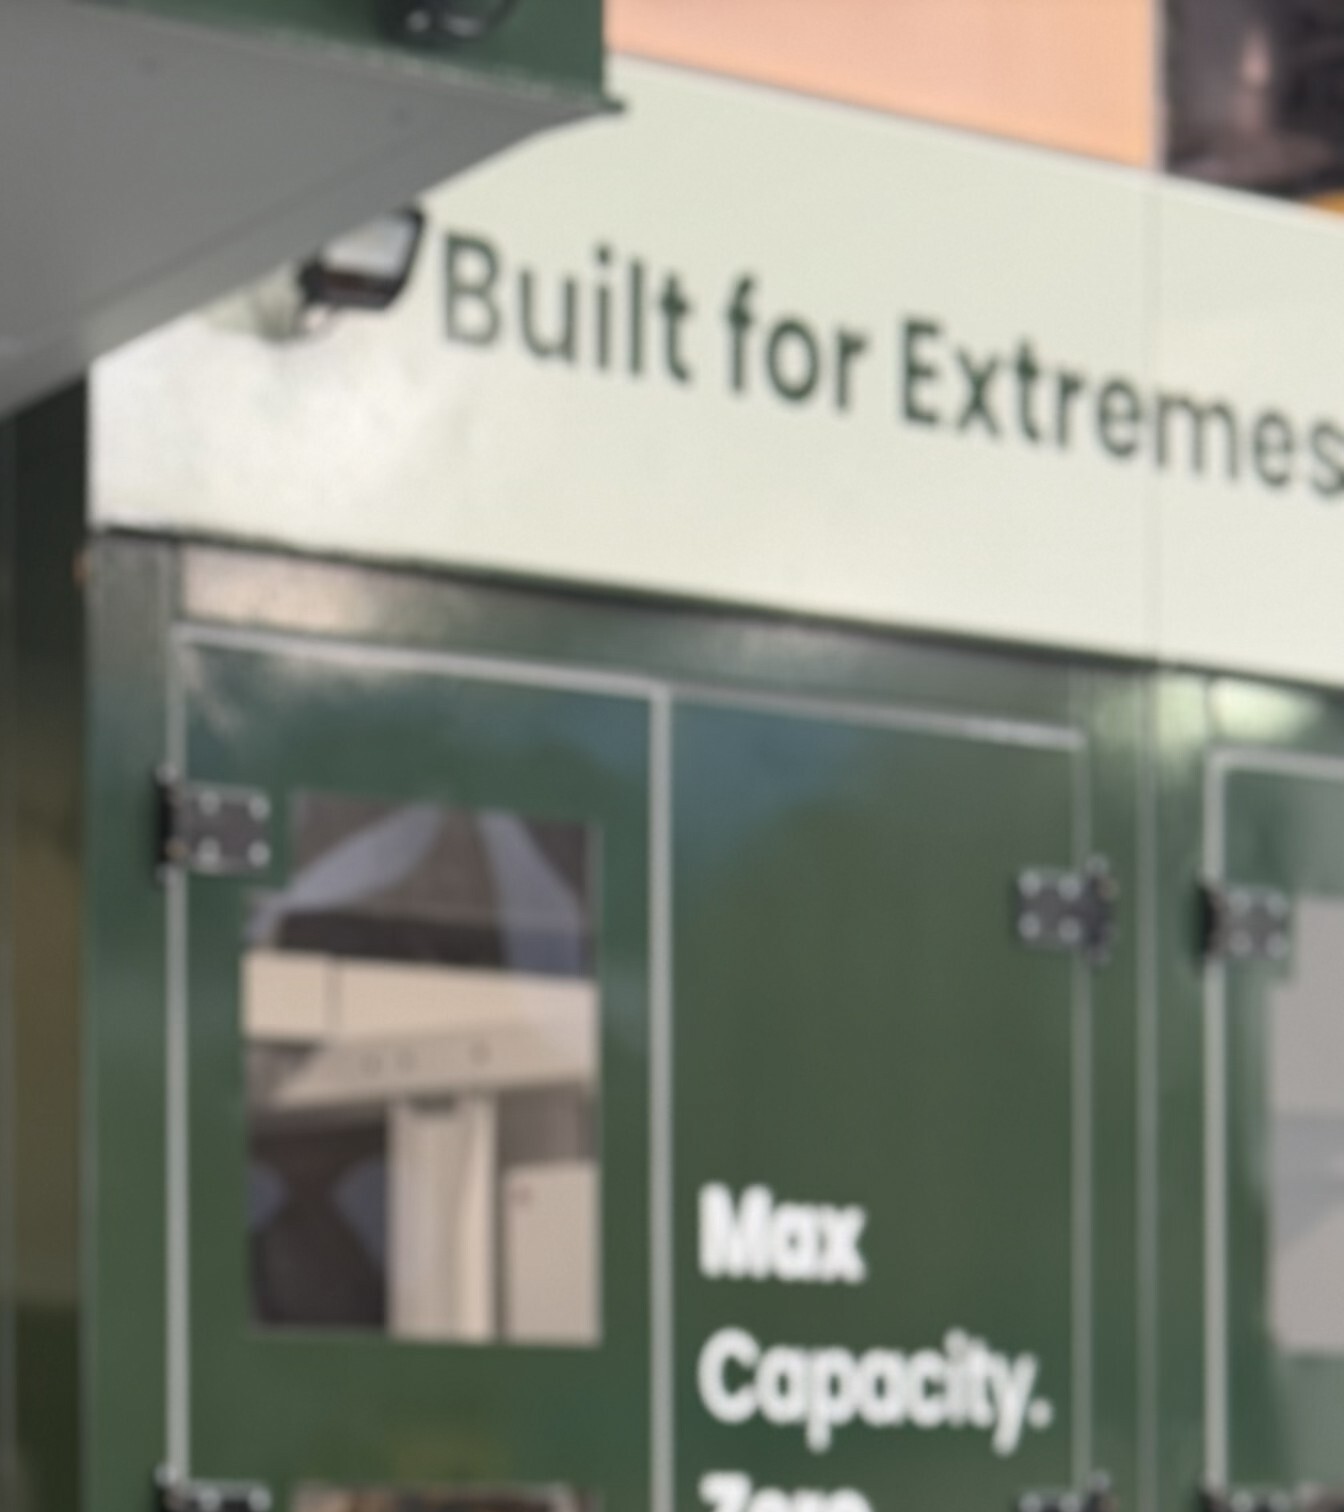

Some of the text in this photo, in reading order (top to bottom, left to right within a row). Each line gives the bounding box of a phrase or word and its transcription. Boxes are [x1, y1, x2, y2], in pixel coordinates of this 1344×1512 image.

[439, 233, 693, 386] Built
[724, 273, 866, 413] for
[698, 1183, 866, 1283] Max
[697, 1327, 1052, 1455] Capacity.
